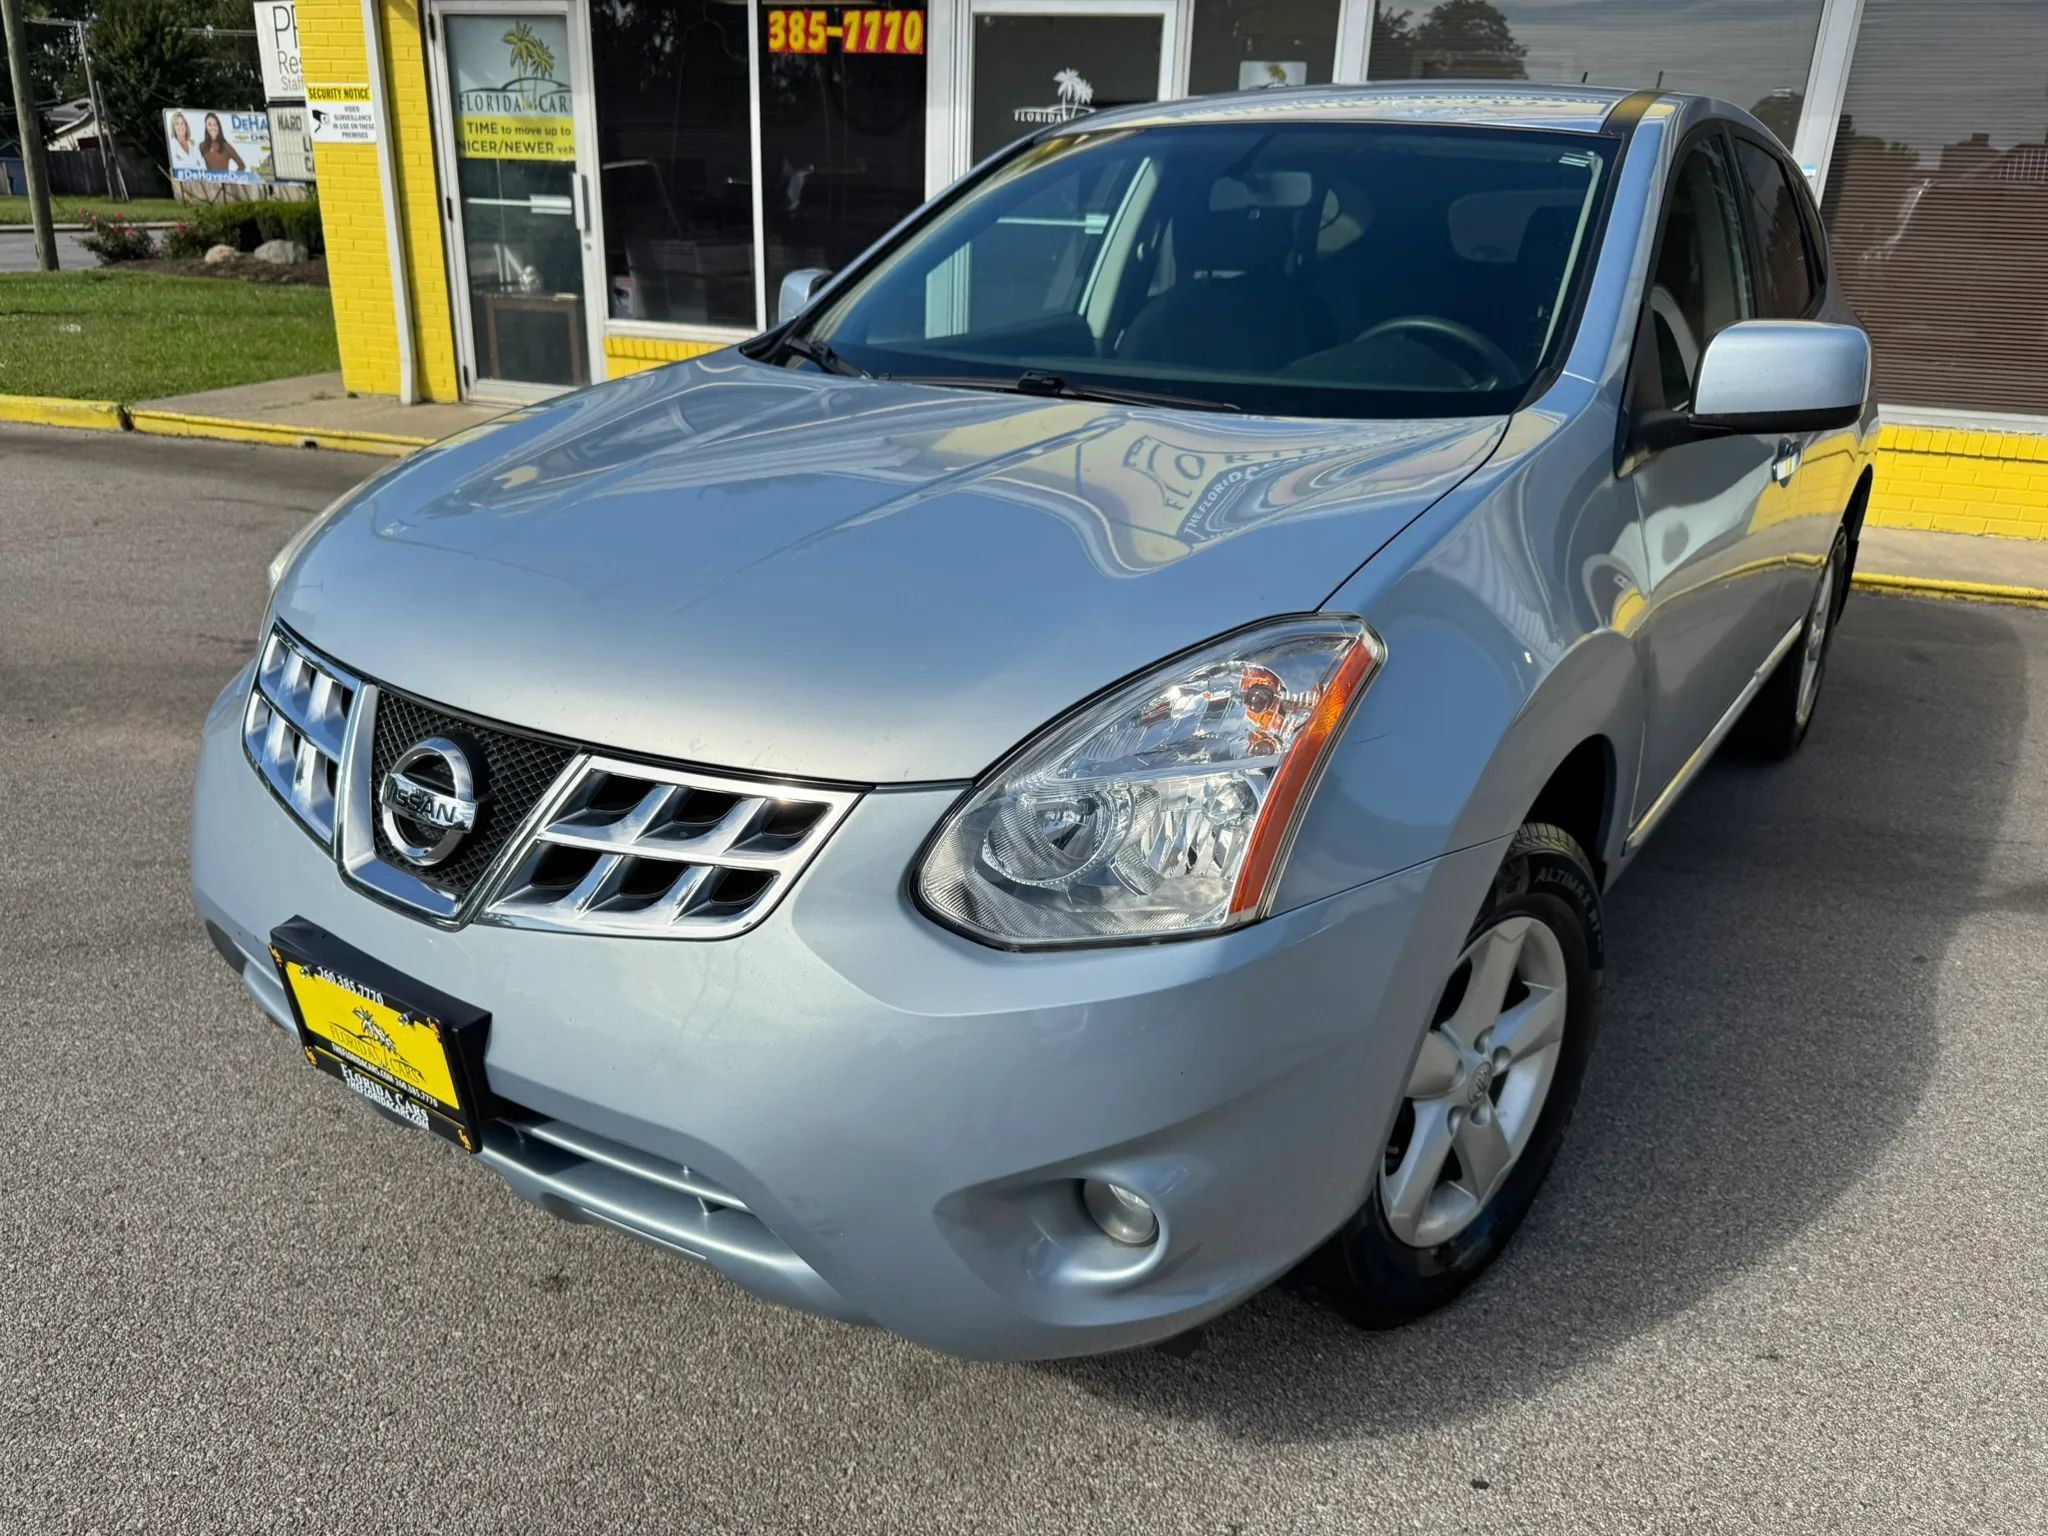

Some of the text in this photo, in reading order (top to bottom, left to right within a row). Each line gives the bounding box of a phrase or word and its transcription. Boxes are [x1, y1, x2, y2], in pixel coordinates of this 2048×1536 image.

[769, 10, 922, 50] 385-7770
[308, 88, 370, 100] SECURITY NOTICE
[344, 105, 360, 113] VIDEO
[458, 93, 572, 113] FLORIDA CAR
[333, 114, 372, 122] SURVEILLANCE
[466, 121, 572, 139] TIME to move up to
[342, 131, 369, 139] PREMISES
[177, 170, 249, 182] #DeHavenDuo
[382, 777, 456, 823] NISSAN
[1534, 866, 1592, 908] ALTIMAX
[316, 965, 385, 1007] 260.385.7770
[329, 1024, 421, 1084] FLORIDA CARS
[340, 1063, 429, 1121] FLORIDA CARS
[345, 1077, 430, 1131] THEFLORIDACARS.COM
